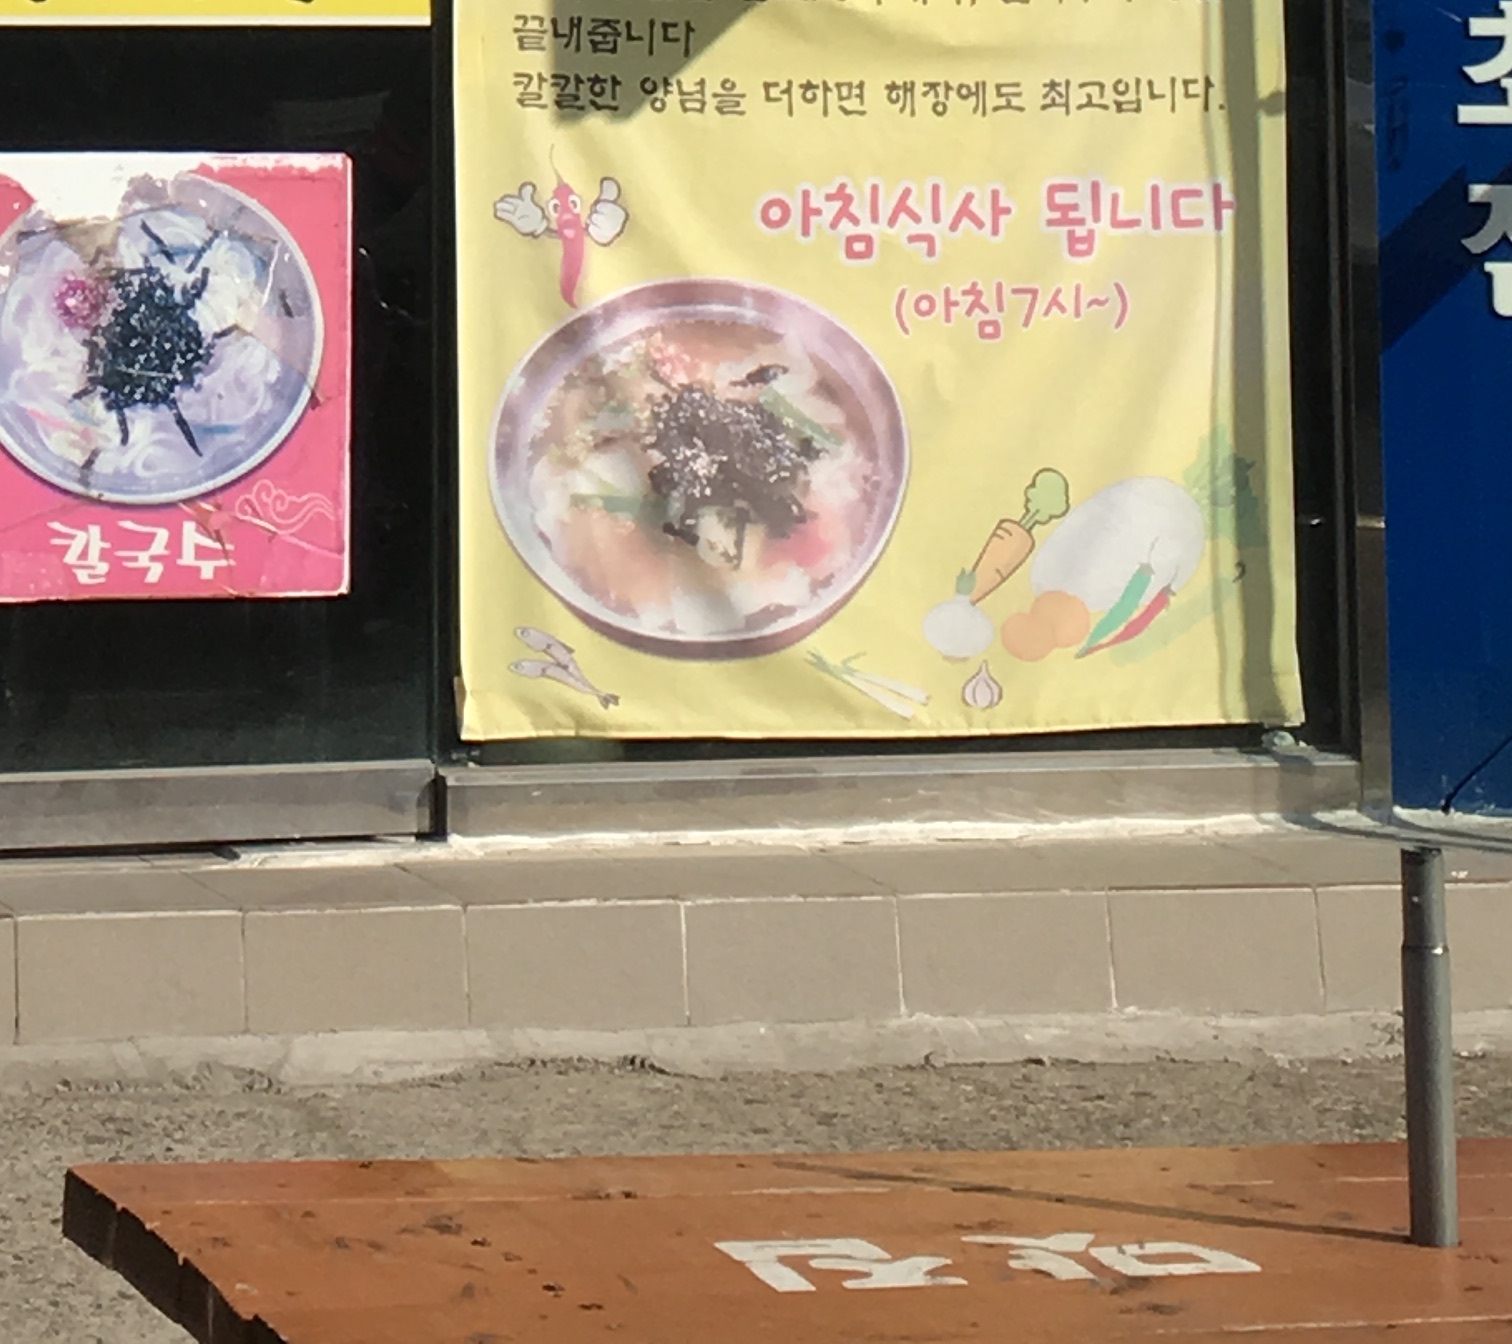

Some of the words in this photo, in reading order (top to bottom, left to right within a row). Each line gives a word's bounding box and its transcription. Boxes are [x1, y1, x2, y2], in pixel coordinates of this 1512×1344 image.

[513, 71, 622, 112] 칼칼한
[640, 76, 746, 115] 양념을
[763, 79, 868, 117] 더하면
[886, 79, 1026, 117] 해장에도
[1041, 76, 1226, 115] 최고입니다.
[759, 183, 1012, 260] 아침식사
[1044, 181, 1236, 256] 됩니다
[46, 520, 237, 585] 칼국수
